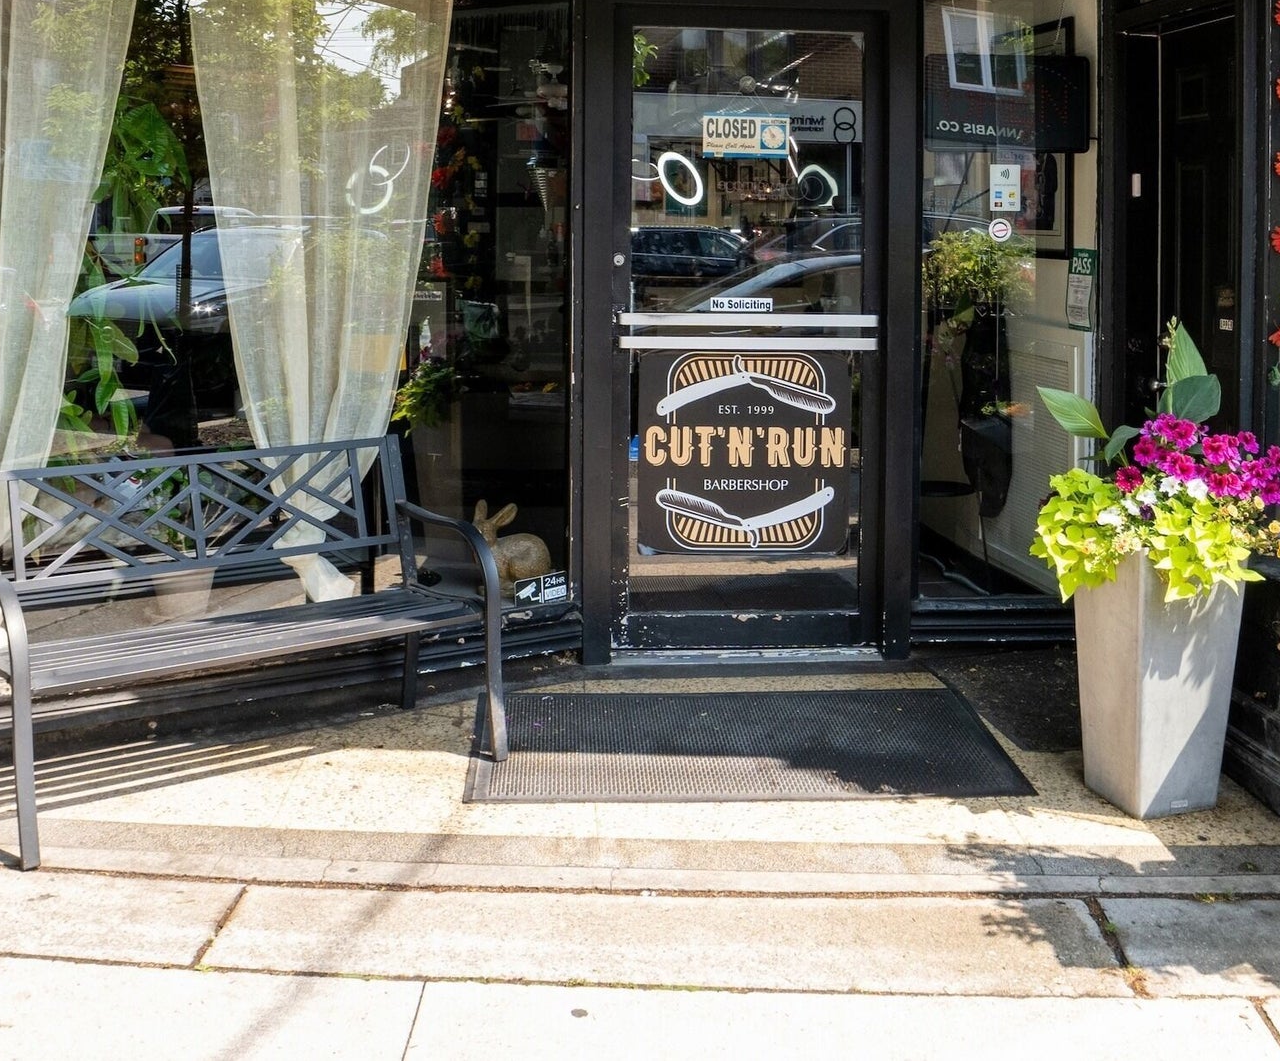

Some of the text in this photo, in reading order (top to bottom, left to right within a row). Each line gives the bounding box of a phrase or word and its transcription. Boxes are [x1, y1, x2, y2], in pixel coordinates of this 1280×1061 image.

[706, 118, 757, 139] CLOSED
[724, 140, 738, 150] Call
[738, 142, 756, 150] Again
[1071, 256, 1092, 274] PASS
[712, 299, 771, 311] No Soliciting
[718, 405, 775, 415] EST. 1999
[643, 425, 847, 468] CUT'N'RUN
[703, 478, 789, 491] BARBERSHOP
